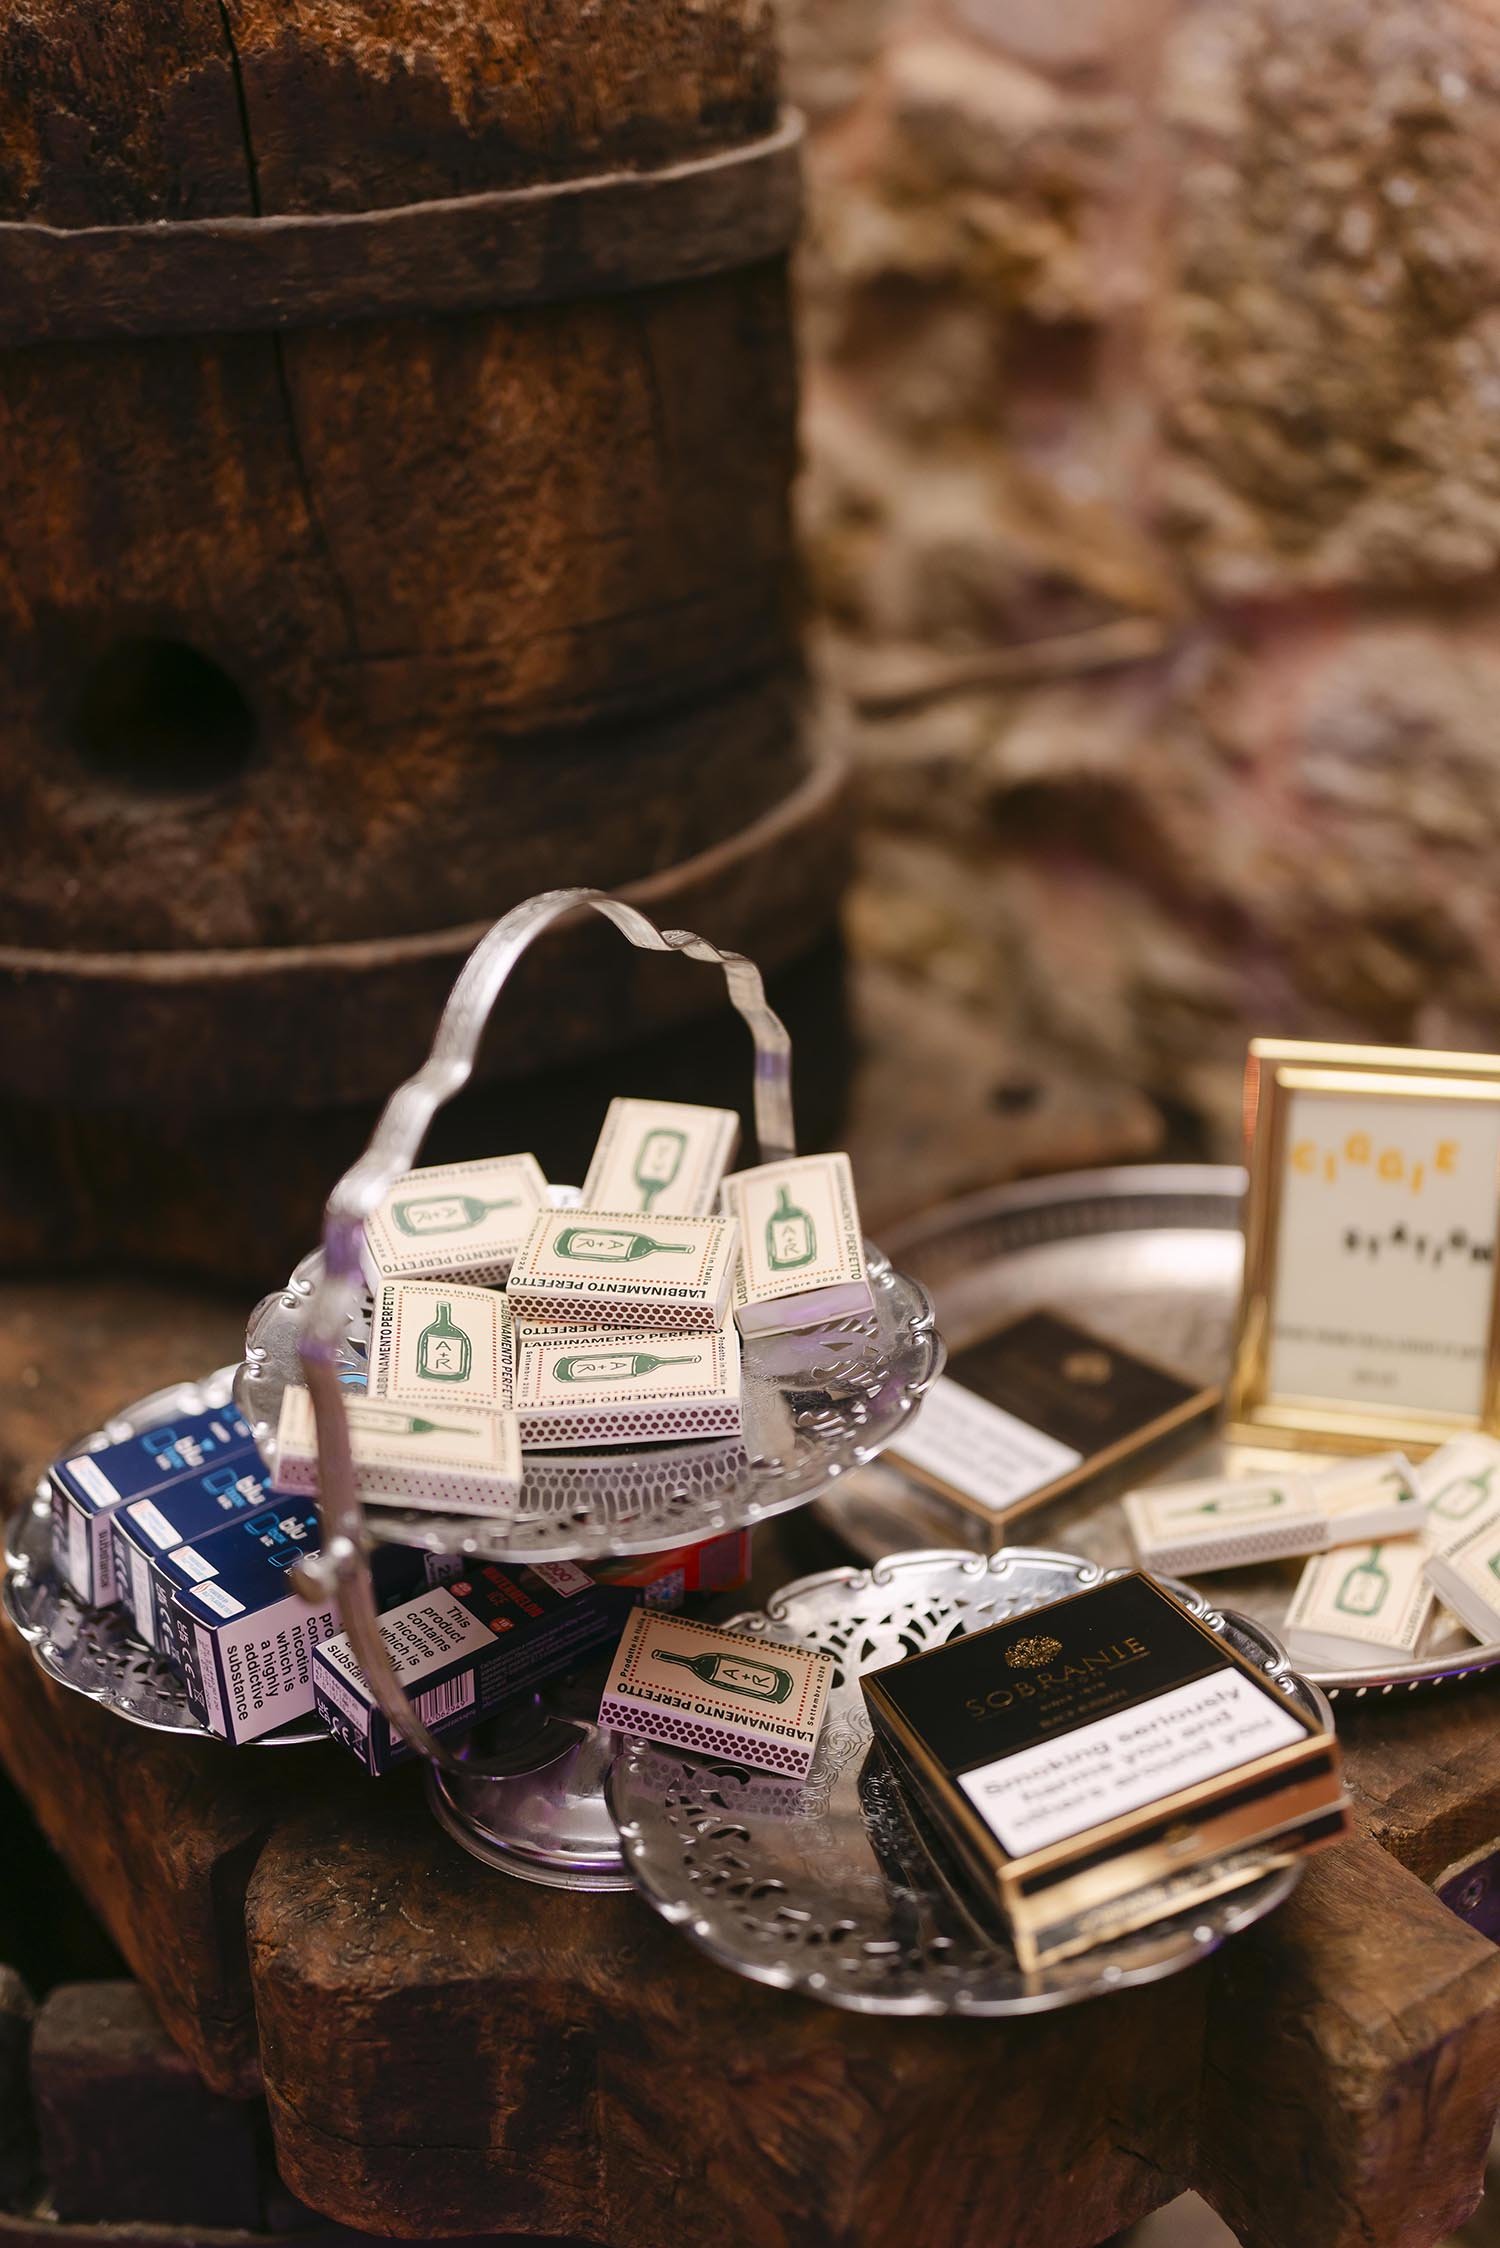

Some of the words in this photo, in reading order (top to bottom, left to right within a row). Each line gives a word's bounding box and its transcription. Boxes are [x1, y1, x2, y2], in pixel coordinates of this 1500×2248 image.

[655, 1214, 727, 1225] PERFETTO
[383, 1255, 452, 1274] PERFETTO
[517, 1251, 529, 1271] 2026
[846, 1233, 862, 1280] PERFETTO
[510, 1276, 583, 1289] PERFETTO
[815, 1274, 842, 1284] 2026
[381, 1285, 395, 1327] PERFETTO
[522, 1324, 598, 1336] PERFETTO
[501, 1364, 514, 1411] PERFETTO
[517, 1397, 596, 1409] PERFETTO
[406, 1612, 451, 1652] contains
[420, 1606, 466, 1644] product
[446, 1606, 471, 1629] This
[633, 1616, 646, 1636] Italia
[260, 1639, 271, 1651] a
[292, 1625, 310, 1685] nicotine
[378, 1627, 410, 1656] which
[406, 1653, 421, 1666] is
[392, 1620, 435, 1659] nicotine
[631, 1635, 640, 1644] in
[759, 1636, 832, 1663] PERFETTO
[244, 1643, 264, 1710] addictive
[262, 1651, 280, 1698] highly
[276, 1631, 292, 1676] which
[284, 1677, 296, 1692] is
[619, 1644, 639, 1678] Prodotto
[963, 1636, 1147, 1718] SOBRANIE
[227, 1645, 249, 1721] substance
[616, 1682, 692, 1711] PERFETTO
[807, 1689, 822, 1727] Settembre
[816, 1665, 827, 1687] 2026
[694, 1703, 815, 1743] L'ABBINAMENTO
